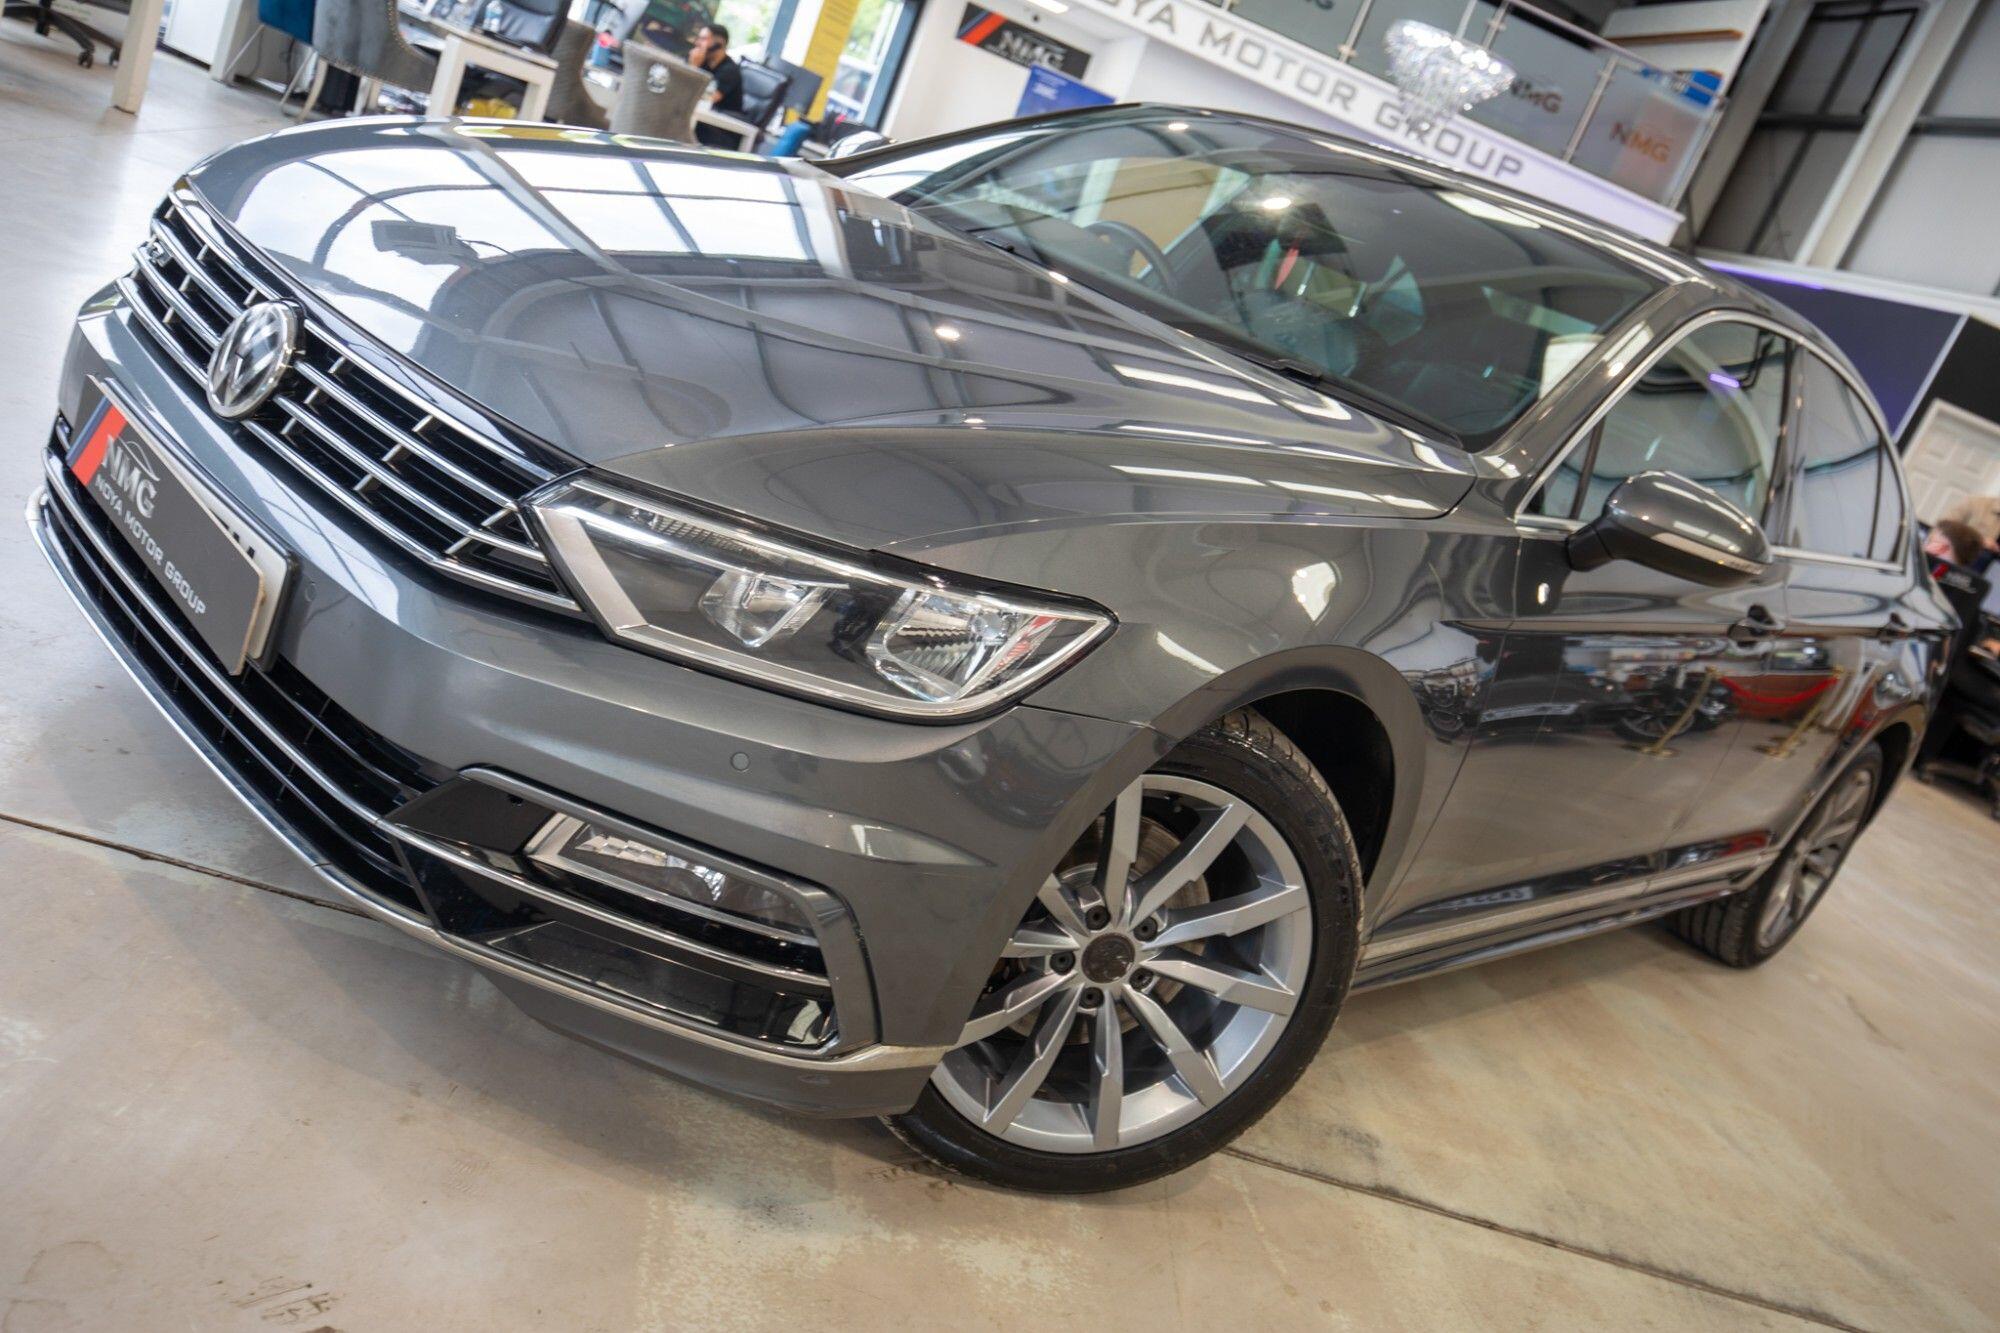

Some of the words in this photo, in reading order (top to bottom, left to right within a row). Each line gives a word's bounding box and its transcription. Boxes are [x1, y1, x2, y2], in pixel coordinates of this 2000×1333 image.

[999, 30, 1065, 69] NMG
[1200, 21, 1358, 111] MOTOR
[1375, 101, 1524, 178] GROUP
[1609, 122, 1670, 162] NMG
[102, 434, 157, 518] NMG
[95, 474, 123, 516] NOYA
[124, 510, 164, 566] MOTOR
[164, 561, 207, 615] GROUP
